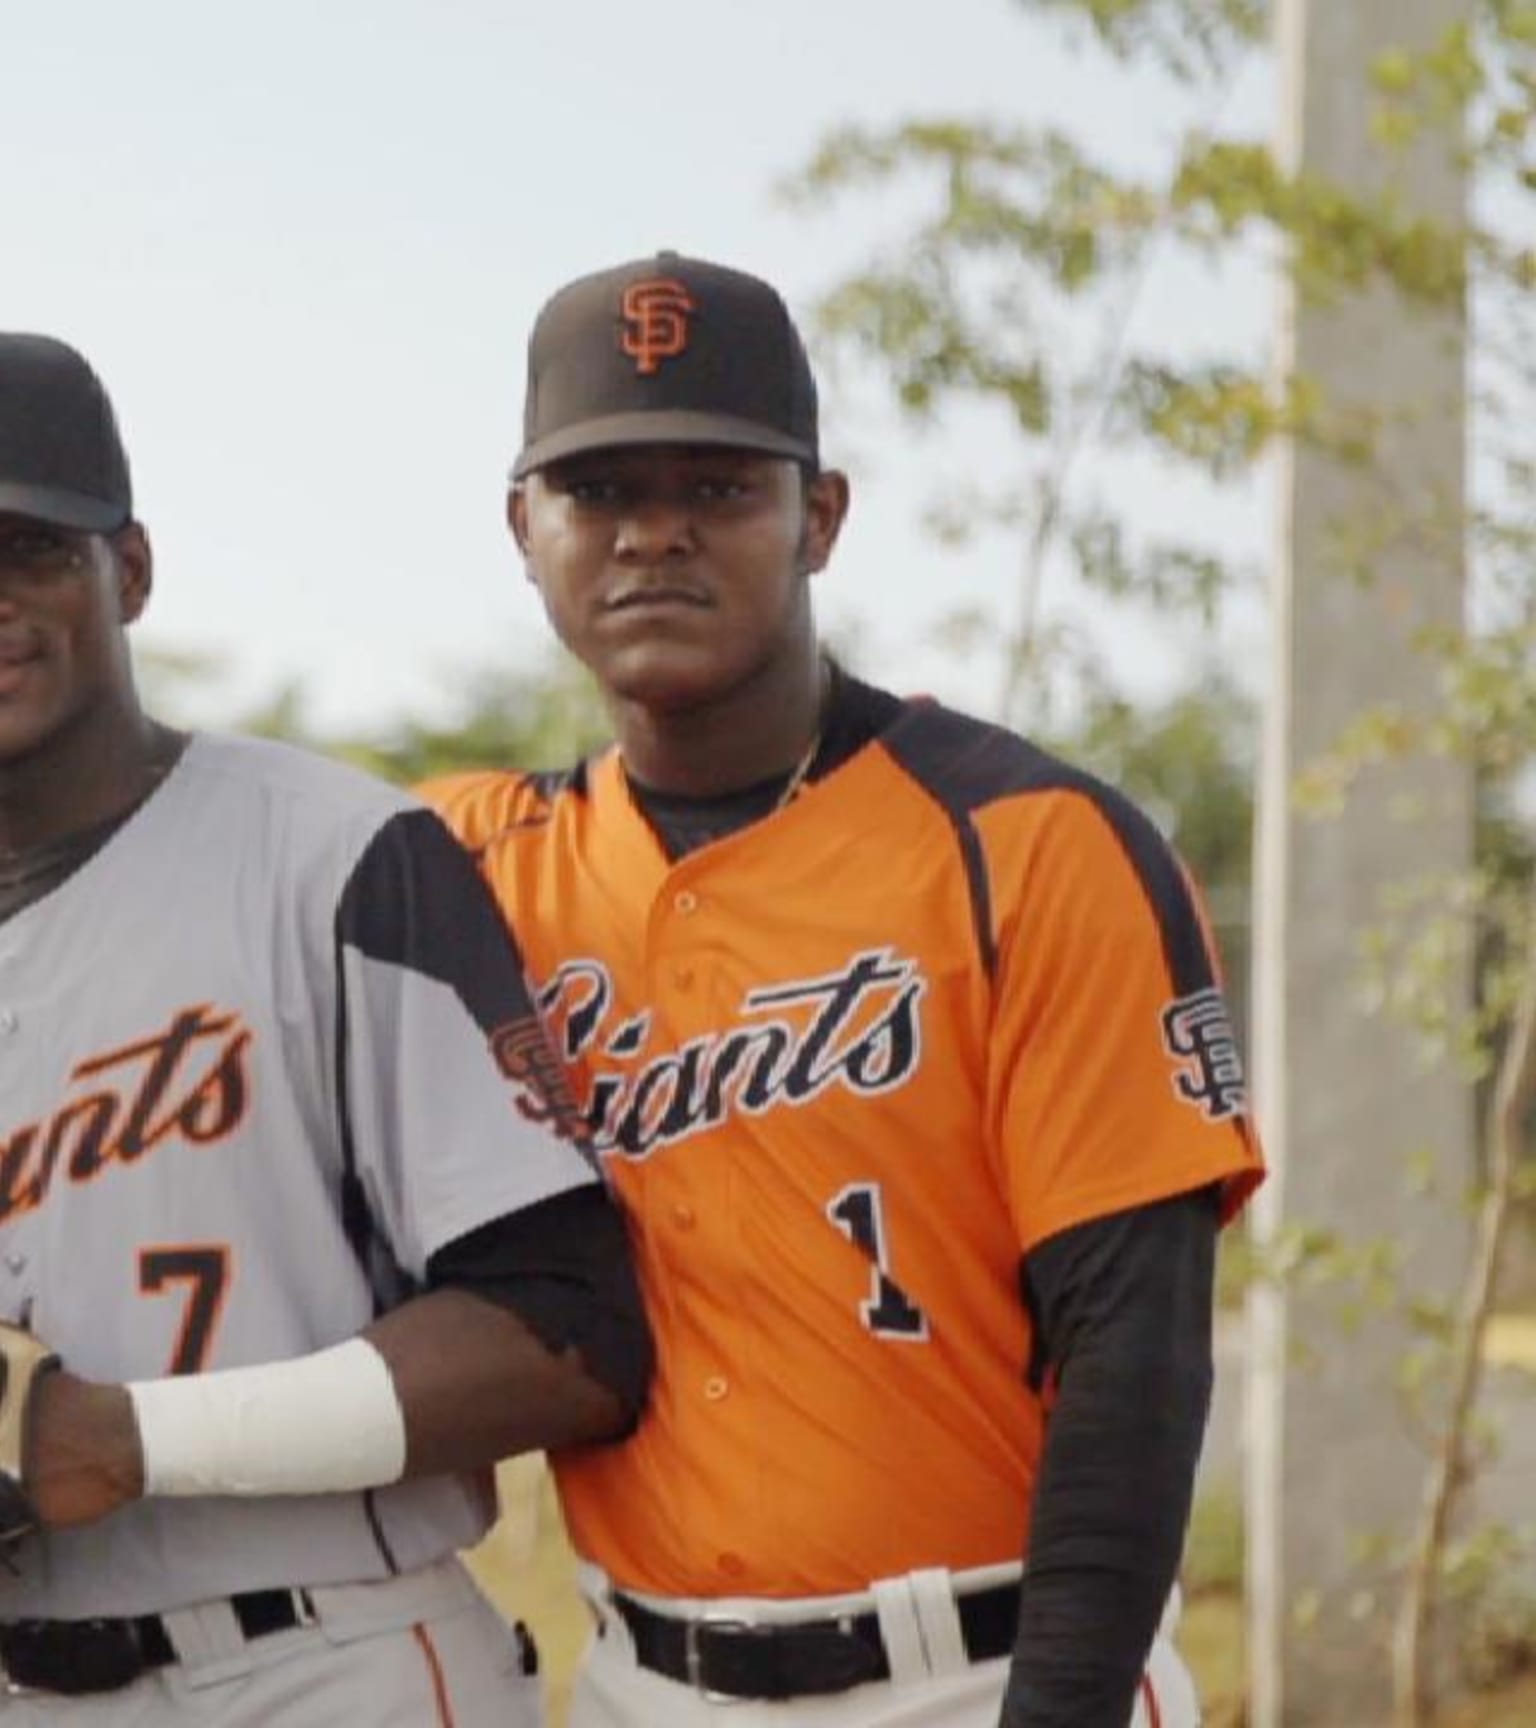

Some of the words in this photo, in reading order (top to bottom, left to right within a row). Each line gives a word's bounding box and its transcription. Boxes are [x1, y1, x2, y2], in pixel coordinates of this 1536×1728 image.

[621, 279, 694, 374] SF
[137, 1244, 231, 1375] 7
[826, 1182, 930, 1343] 1
